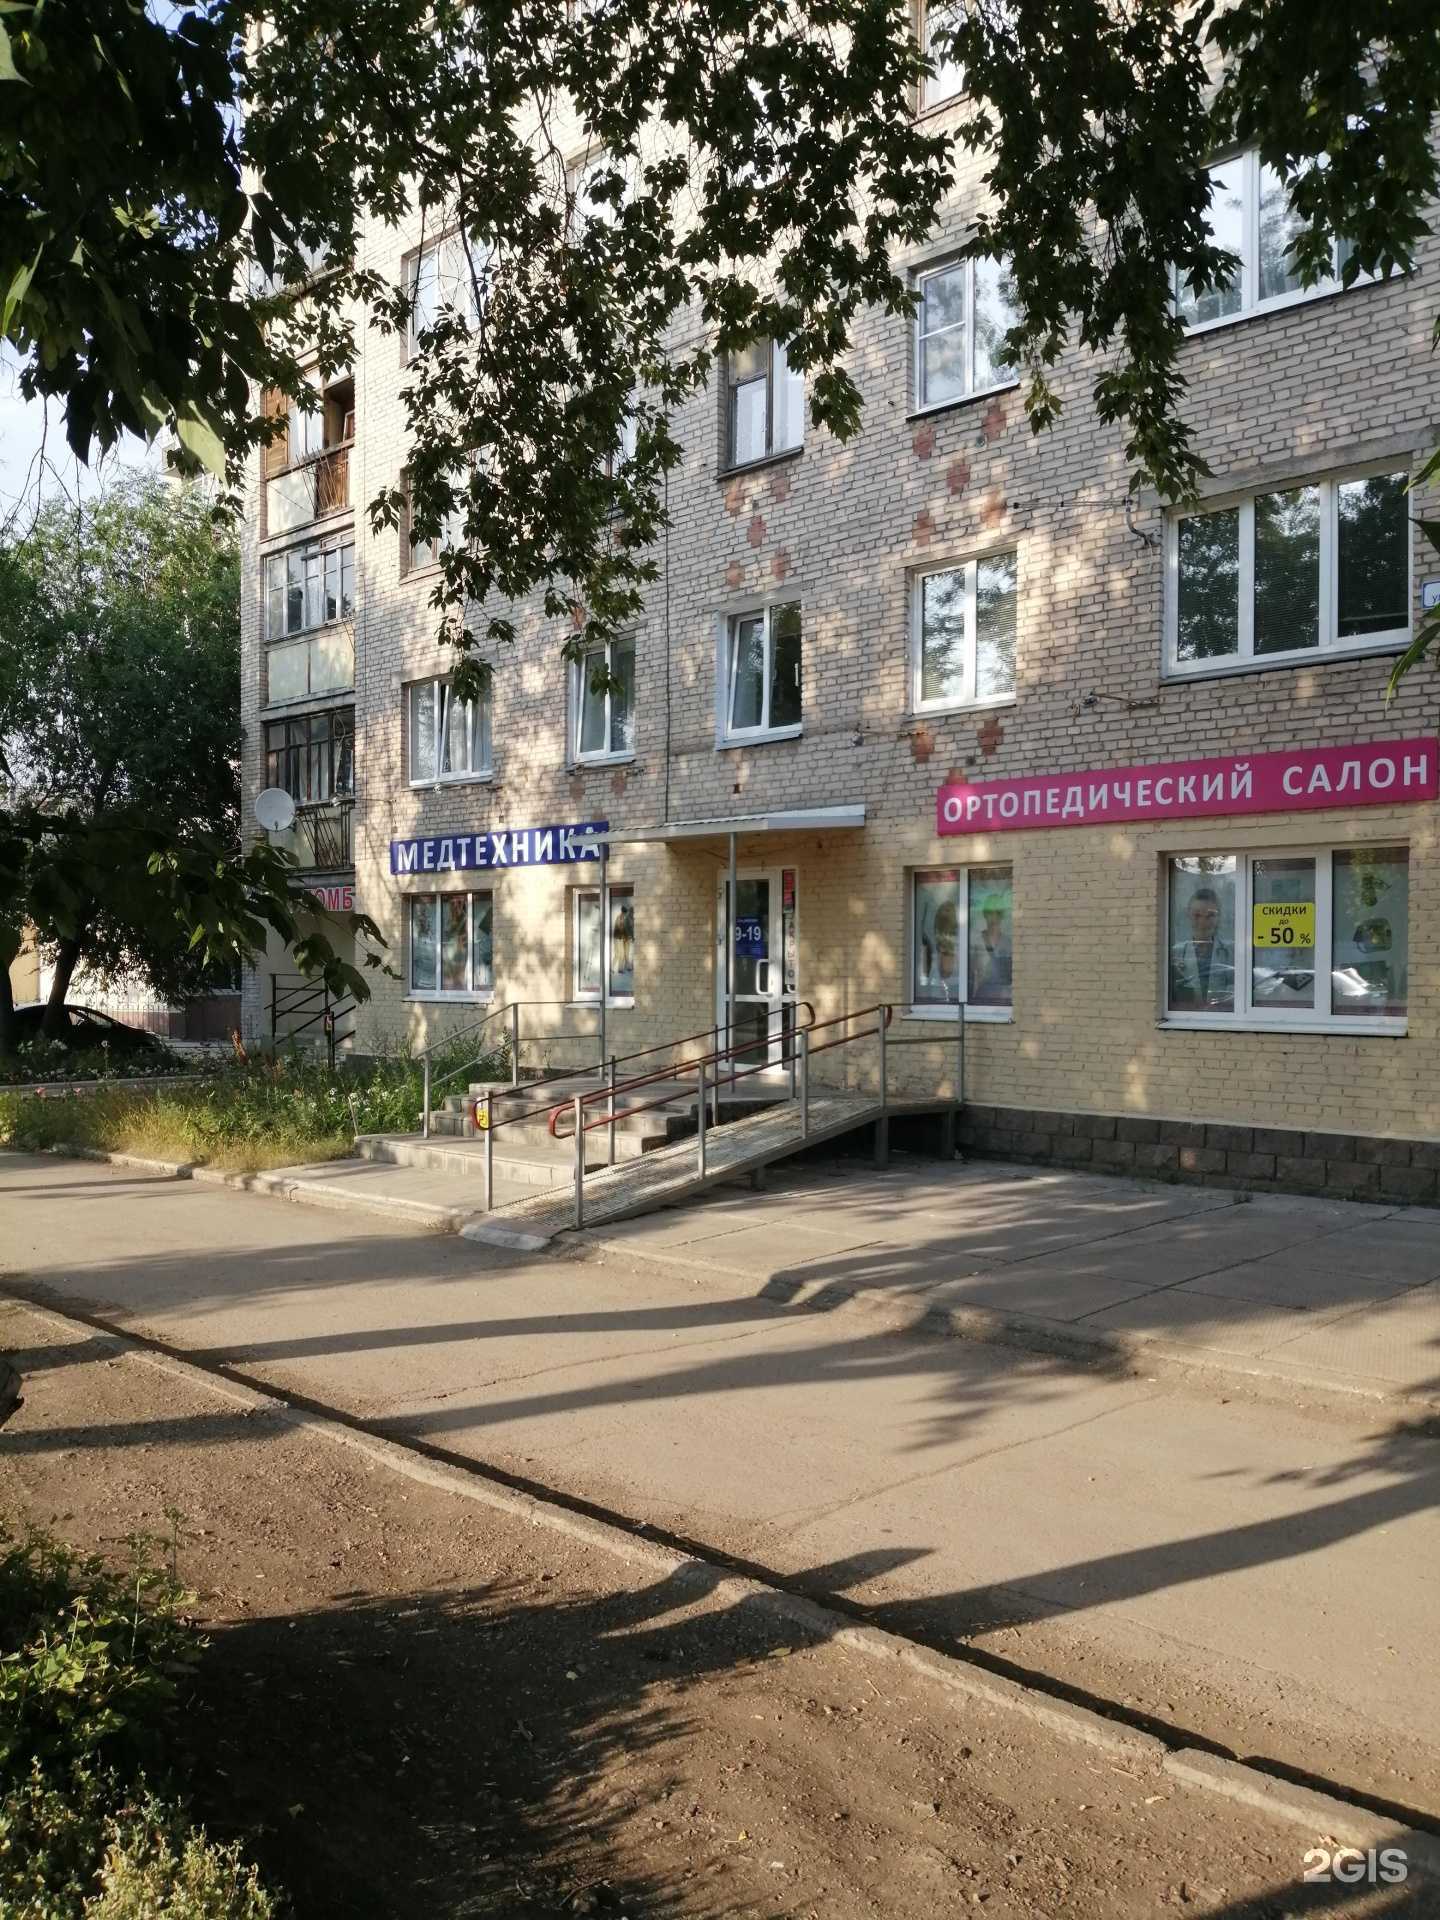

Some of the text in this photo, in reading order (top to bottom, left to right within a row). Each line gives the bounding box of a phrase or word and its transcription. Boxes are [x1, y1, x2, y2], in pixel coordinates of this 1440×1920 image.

[943, 754, 1428, 823] ОРТОПЕДИЧЕСКИЙ САЛОН
[397, 826, 600, 872] МЕДТЕХНИКА
[312, 886, 353, 911] ОМБ
[1262, 905, 1307, 917] СКИДКИ
[1270, 927, 1294, 944] 50
